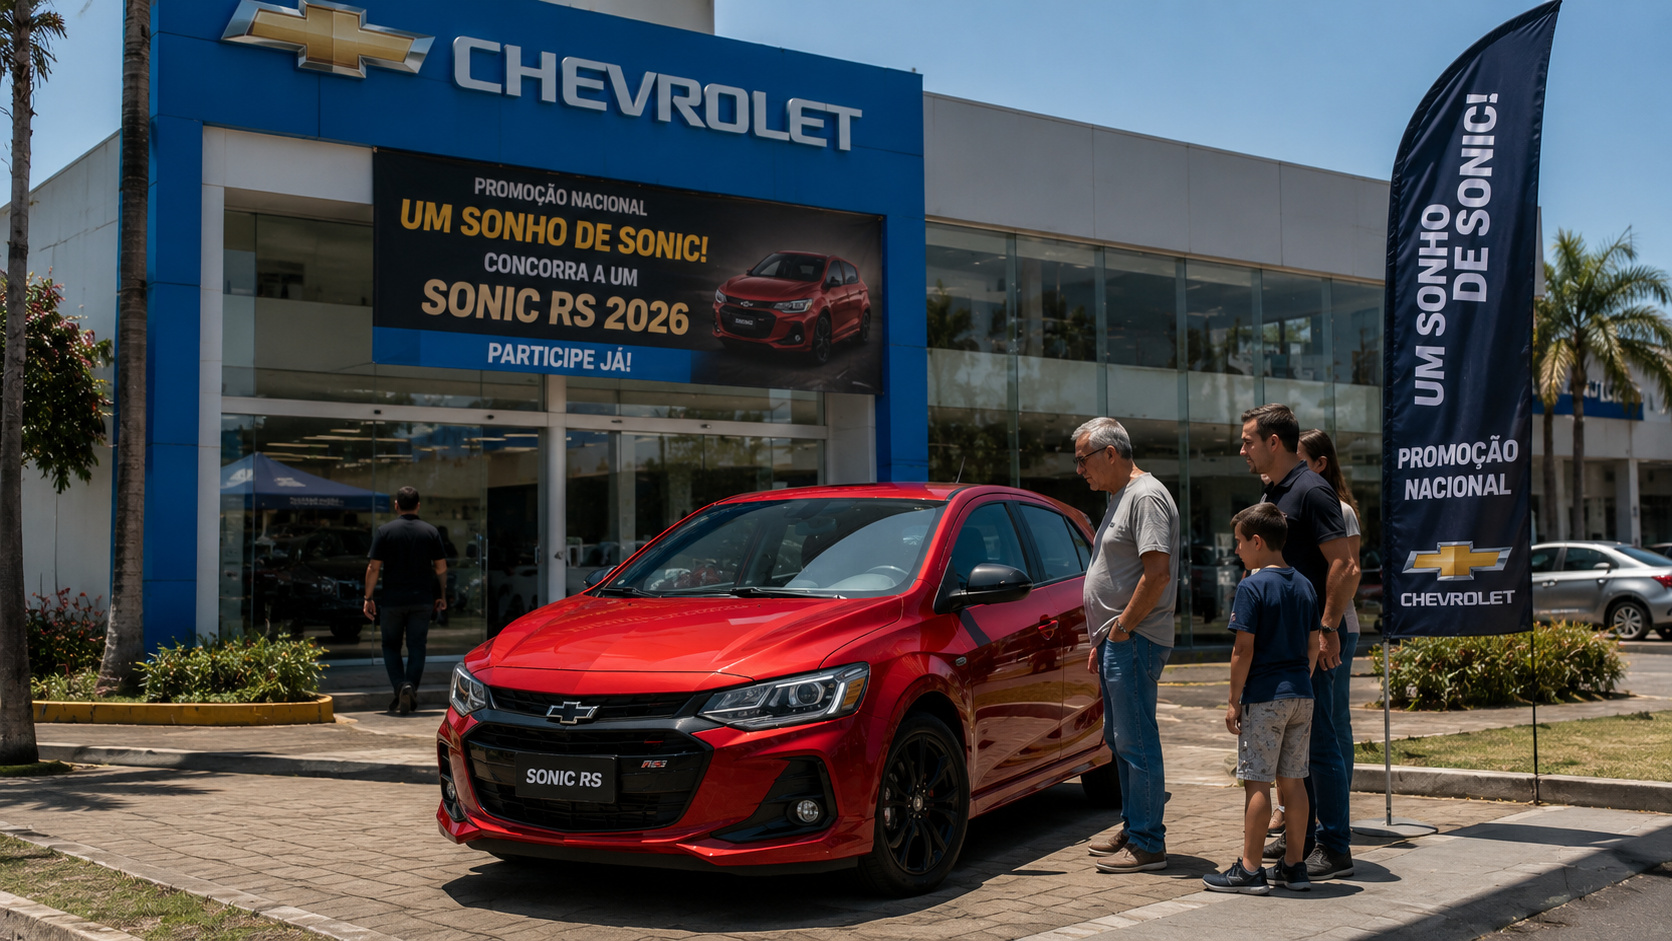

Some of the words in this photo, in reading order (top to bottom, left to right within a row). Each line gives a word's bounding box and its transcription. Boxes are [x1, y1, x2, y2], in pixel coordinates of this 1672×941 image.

[453, 35, 862, 151] CHEVROLET
[1455, 92, 1499, 236] SONIC!
[474, 177, 567, 207] PROMOÇÃO
[571, 190, 648, 216] NACIONAL
[400, 198, 452, 233] UM
[460, 207, 567, 247] SONHO
[575, 220, 612, 252] DE
[617, 226, 709, 263] SONIC!
[484, 252, 589, 282] CONCORRA
[593, 264, 606, 283] A
[610, 266, 638, 287] UM
[1416, 203, 1450, 337] SONHO
[1452, 246, 1489, 302] DE
[421, 279, 539, 323] SONIC
[548, 291, 596, 328] RS
[604, 296, 690, 336] 2026
[487, 342, 594, 370] PARTICIPE
[599, 346, 632, 373] JÁ!
[1414, 345, 1446, 407] UM
[1397, 435, 1519, 470] PROMOÇÃO
[1404, 473, 1512, 501] NACIONAL
[1400, 590, 1515, 607] CHEVROLET
[525, 768, 576, 787] SONIC
[579, 771, 602, 788] RS
